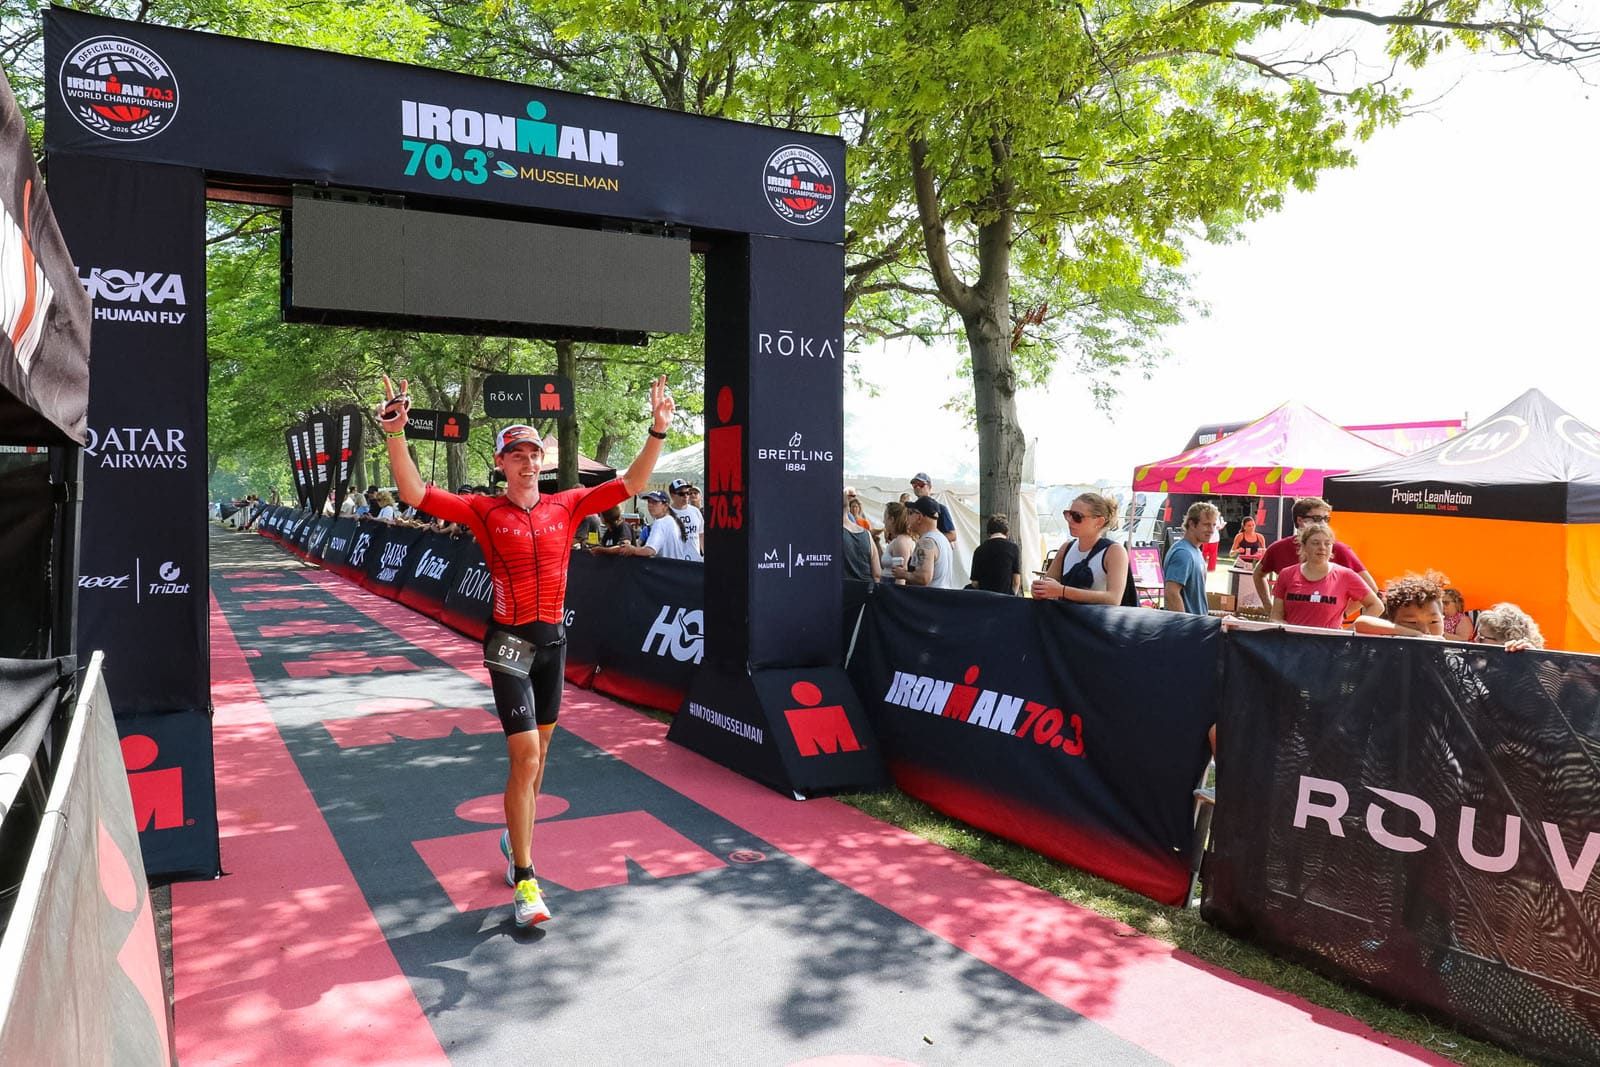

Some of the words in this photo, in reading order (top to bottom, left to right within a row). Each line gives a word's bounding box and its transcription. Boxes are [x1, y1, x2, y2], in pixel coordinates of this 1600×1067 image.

[78, 43, 114, 63] OFFICIAL
[116, 44, 160, 73] QUALIFIER
[67, 75, 144, 97] IRONMAN
[144, 86, 174, 101] 70.3
[67, 89, 102, 100] WORLD
[104, 93, 174, 109] CHAMPIONSHIP
[402, 99, 618, 166] IRONMAN
[402, 140, 489, 185] 70.3
[520, 166, 619, 192] MUSSELMAN
[767, 175, 814, 192] IRONMAN
[767, 185, 789, 194] WORLD
[789, 189, 833, 200] CHAMPIONSHIP
[94, 307, 157, 323] HUMAN
[160, 311, 186, 325] FLY
[100, 453, 188, 469] AIRWAYS
[758, 449, 834, 461] BREITLING
[785, 462, 806, 472] 1884
[1391, 488, 1422, 504] Project
[1424, 488, 1473, 505] LeanNation
[708, 495, 743, 530] 70.3
[513, 522, 564, 538] RACING
[805, 554, 832, 562] ATHLETIC
[149, 583, 191, 594] TriDot
[498, 645, 521, 662] 631
[884, 665, 1025, 735] IRONMAN
[1014, 700, 1085, 757] 70.3
[689, 702, 764, 745] #IM703MUSSELMAN
